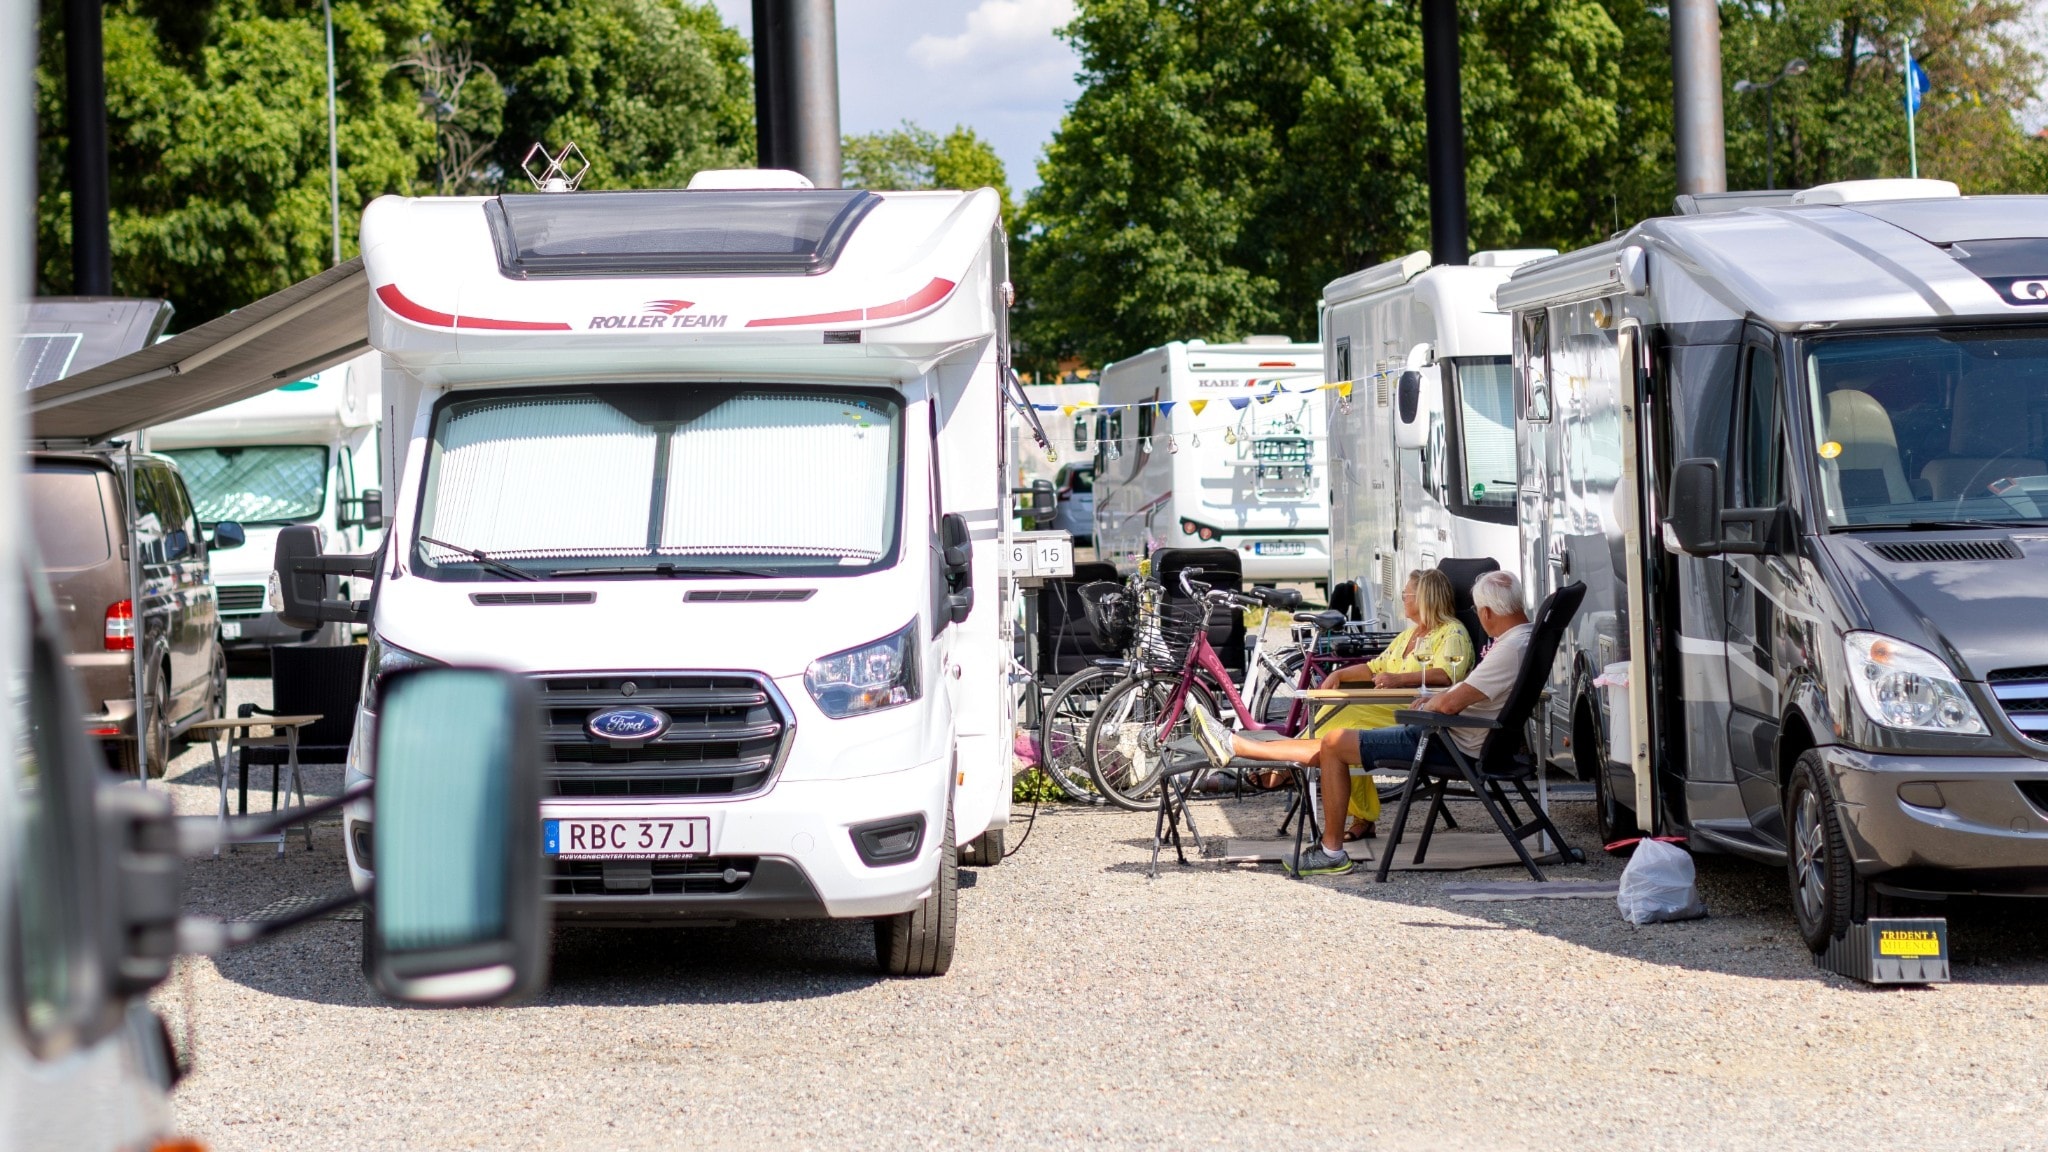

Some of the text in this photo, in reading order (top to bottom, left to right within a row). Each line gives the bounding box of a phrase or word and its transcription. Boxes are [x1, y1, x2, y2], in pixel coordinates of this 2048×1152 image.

[588, 314, 728, 329] ROLLER TEAM
[1198, 379, 1239, 387] KABE
[1041, 548, 1059, 562] 15
[606, 714, 646, 732] Ford
[570, 822, 694, 850] RBC 37J
[549, 839, 556, 848] S
[1881, 930, 1937, 940] TRIDENT 3
